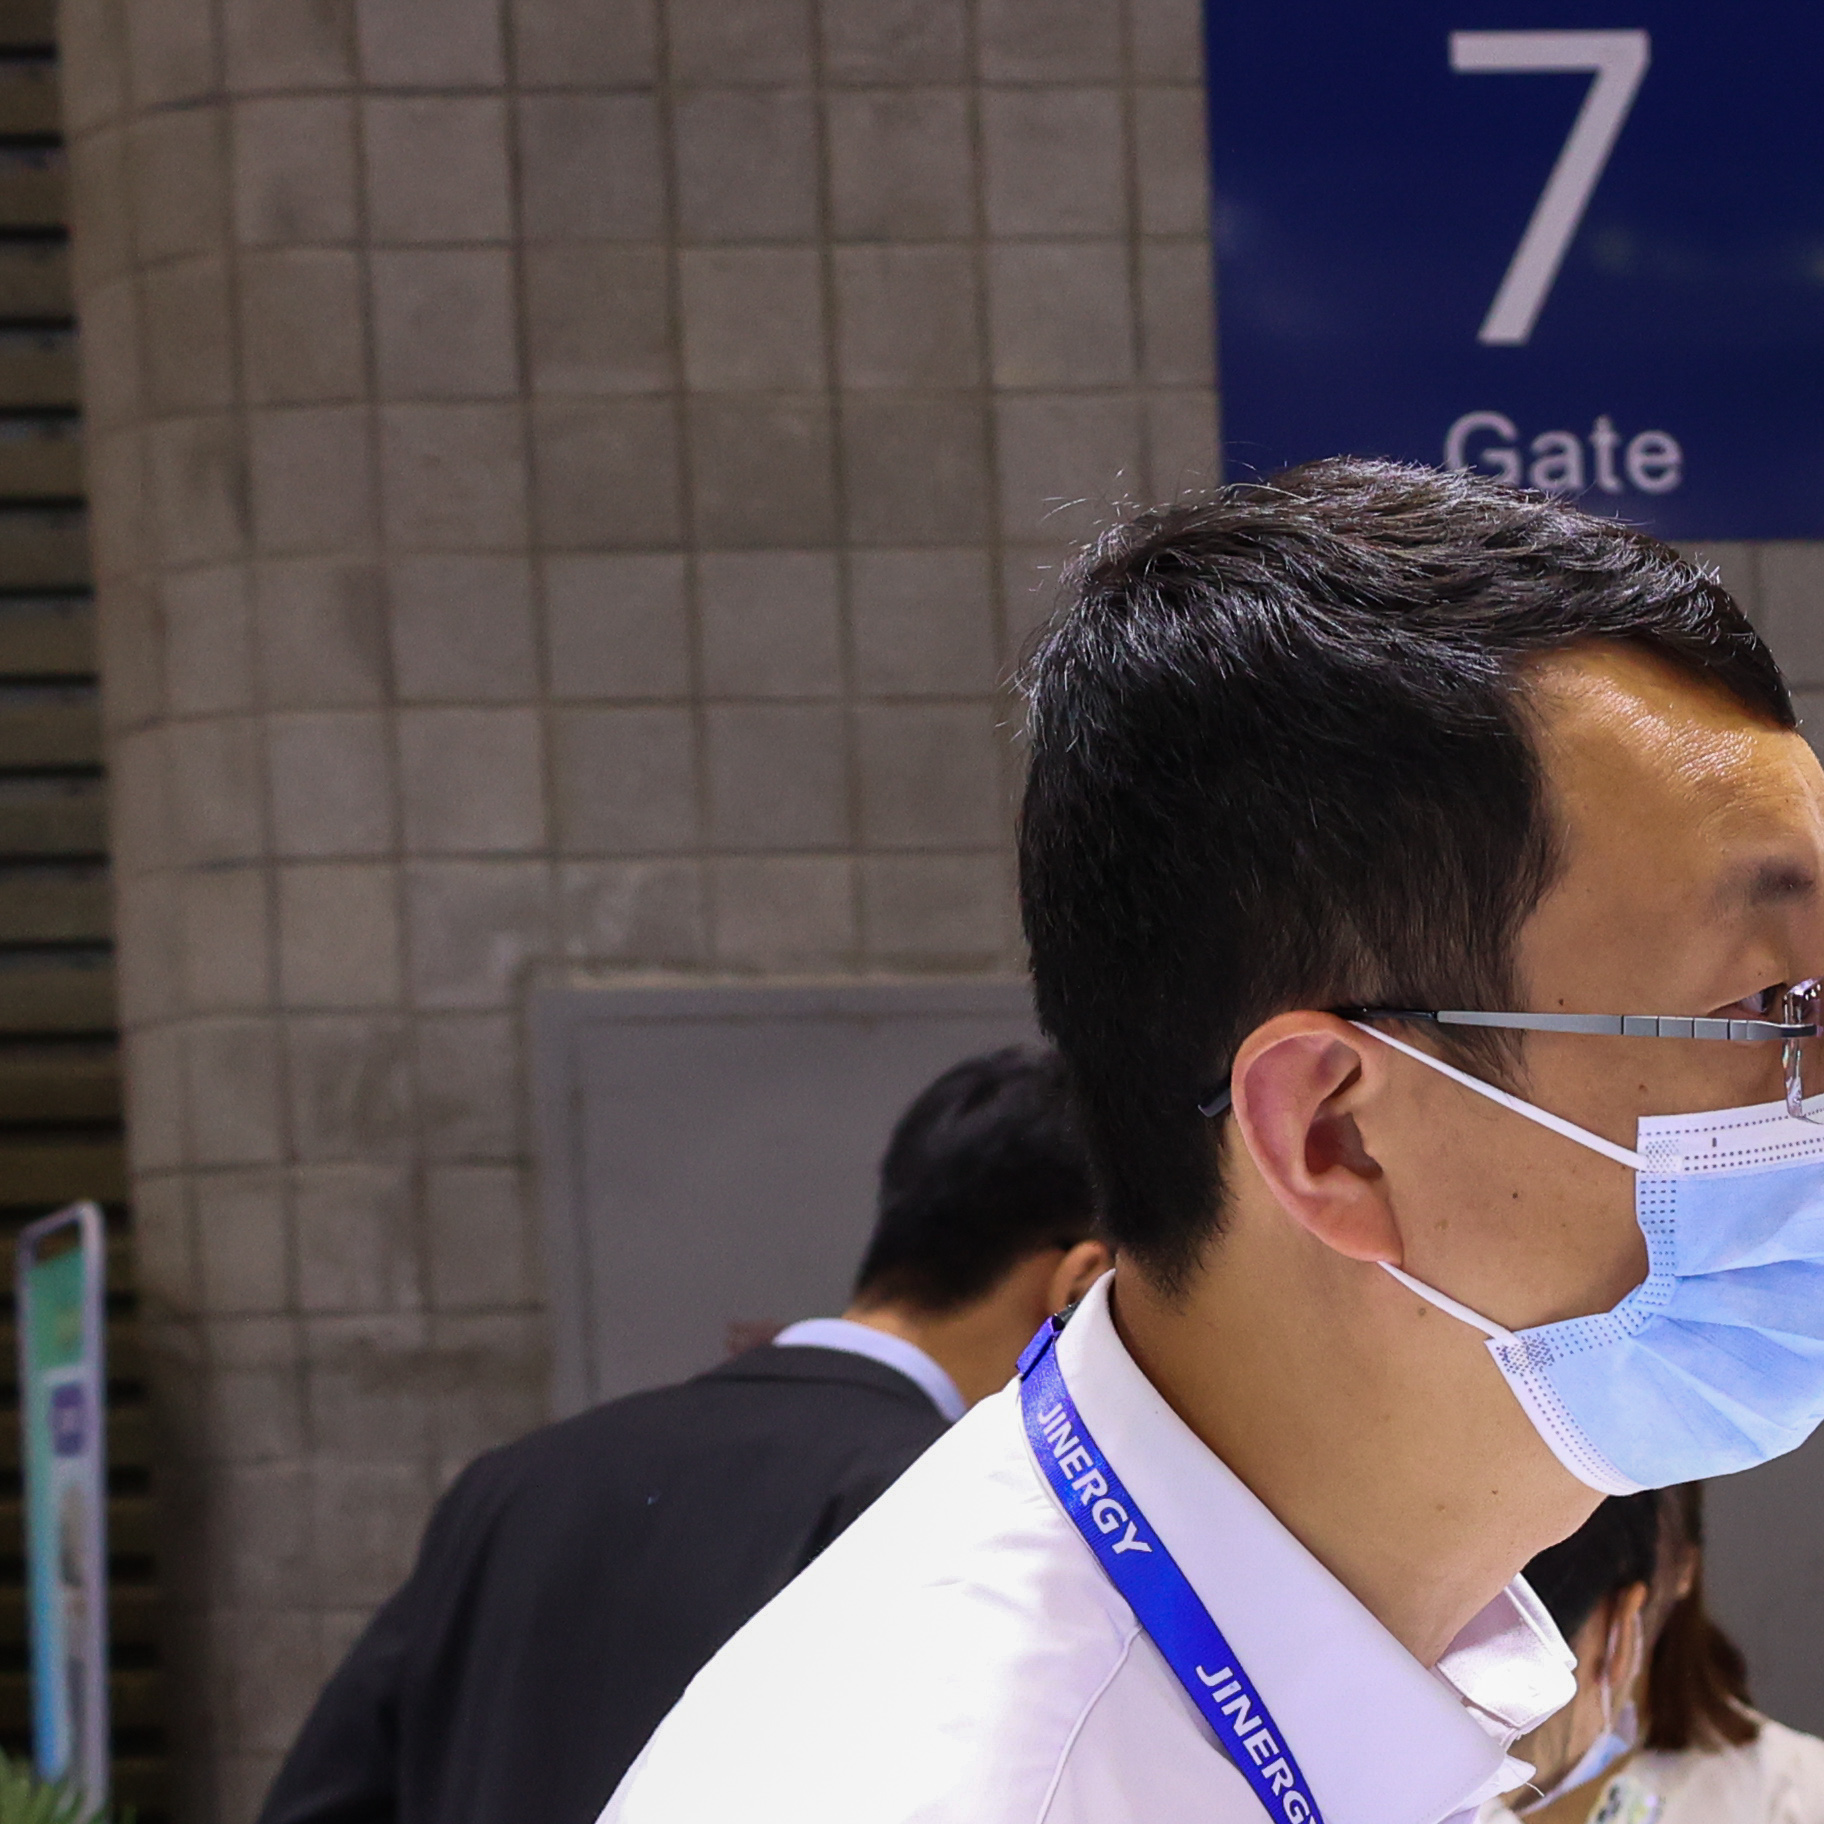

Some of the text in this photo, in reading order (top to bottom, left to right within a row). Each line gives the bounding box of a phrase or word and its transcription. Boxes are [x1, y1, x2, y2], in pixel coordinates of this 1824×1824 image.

[1449, 28, 1652, 345] 7
[1443, 410, 1684, 493] Gate
[1037, 1402, 1152, 1555] JINERGY
